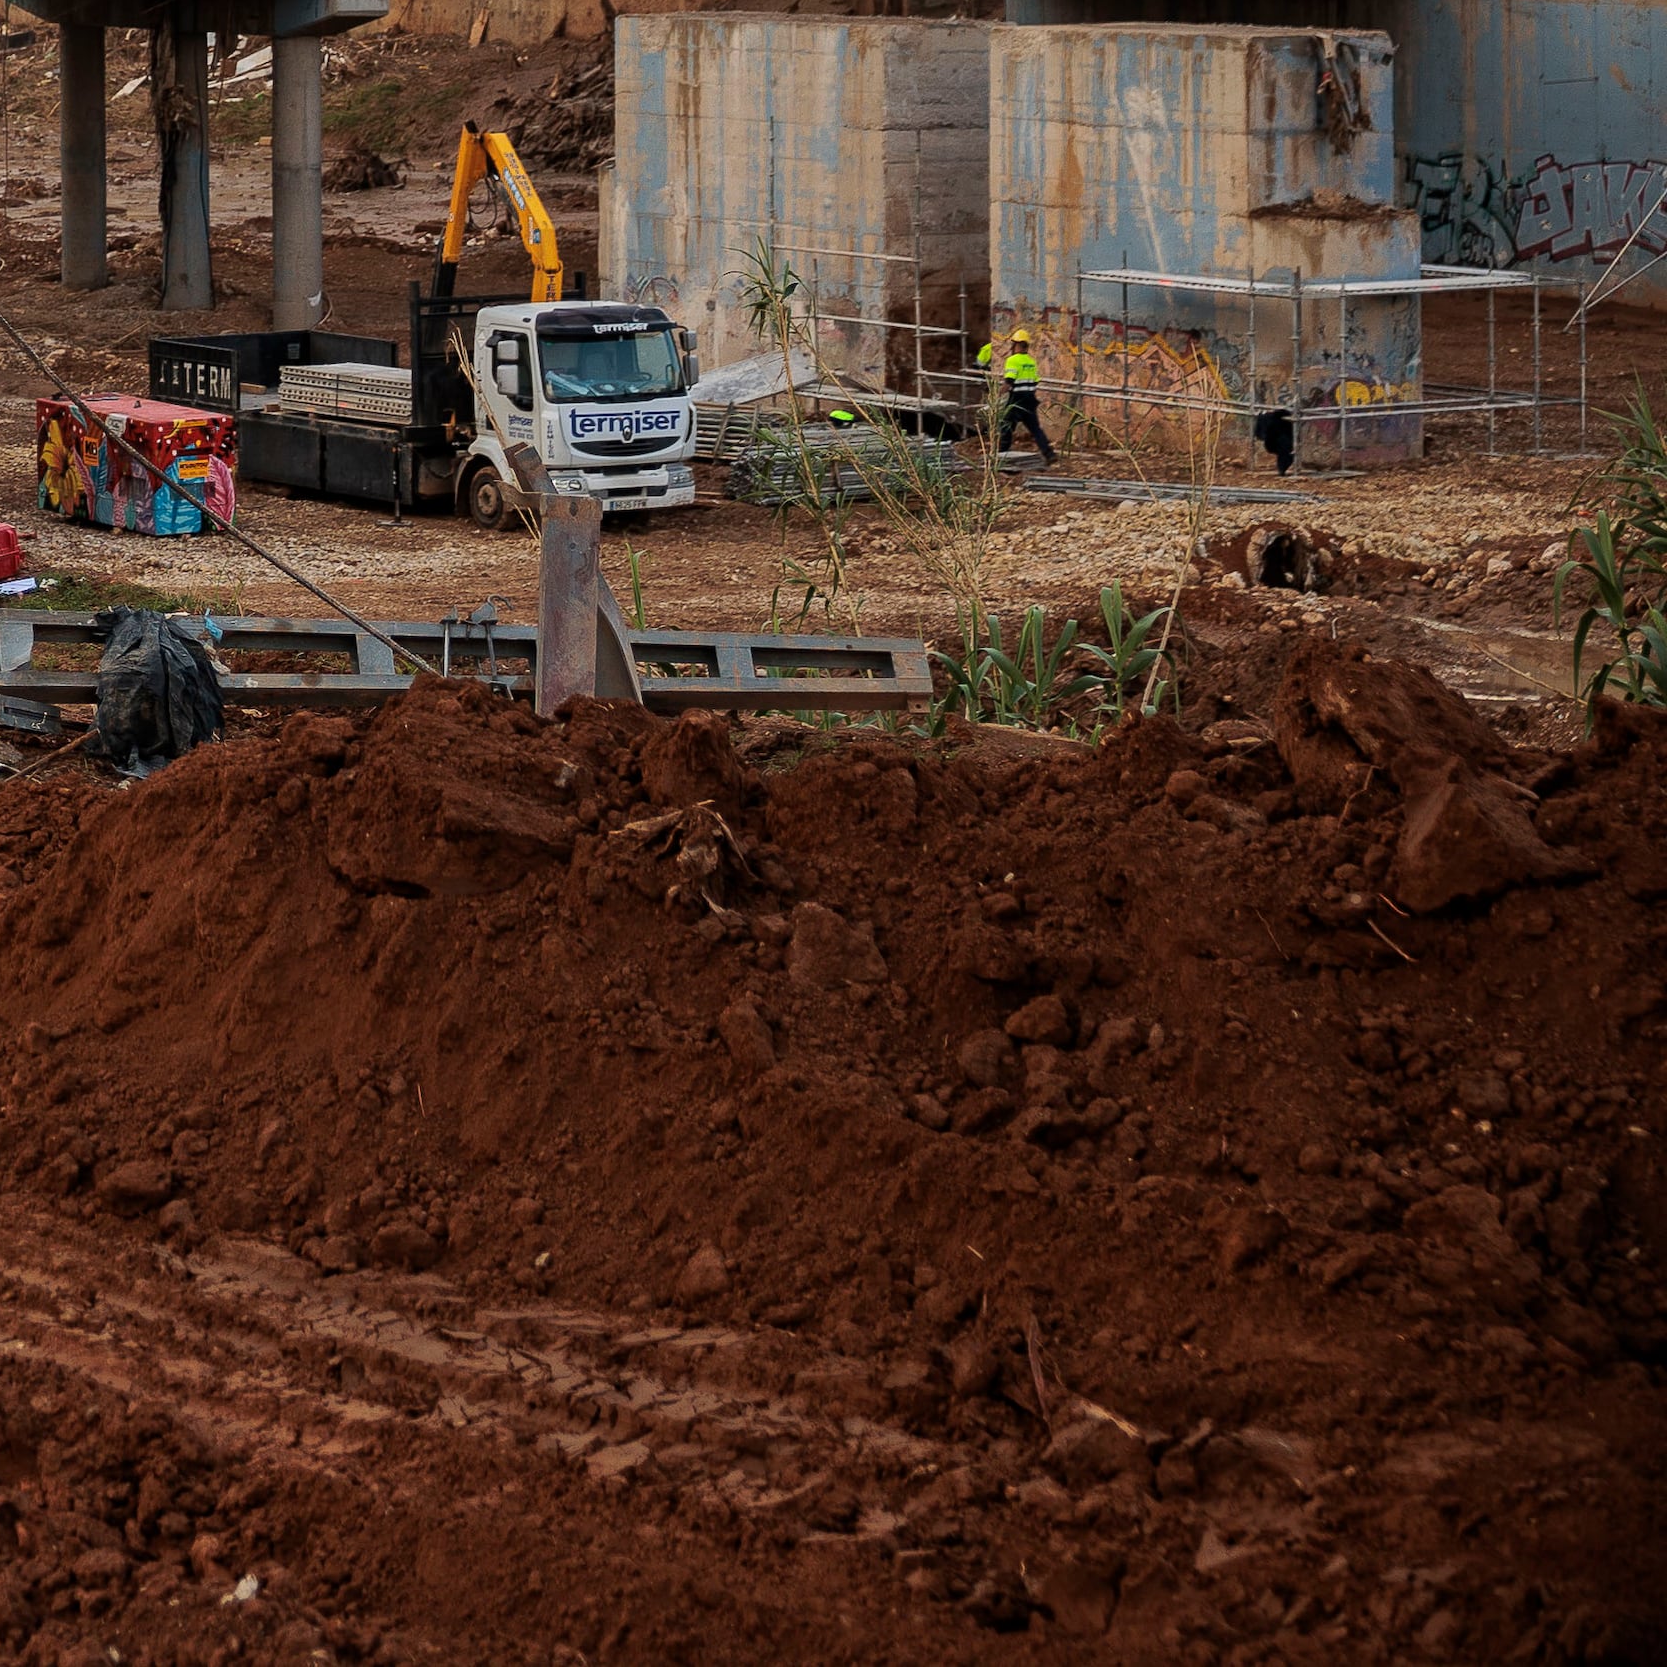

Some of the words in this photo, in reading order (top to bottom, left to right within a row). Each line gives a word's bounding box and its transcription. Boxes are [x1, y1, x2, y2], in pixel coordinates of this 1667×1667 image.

[593, 322, 649, 334] termiser
[183, 362, 231, 400] TERM
[569, 408, 681, 438] termiser
